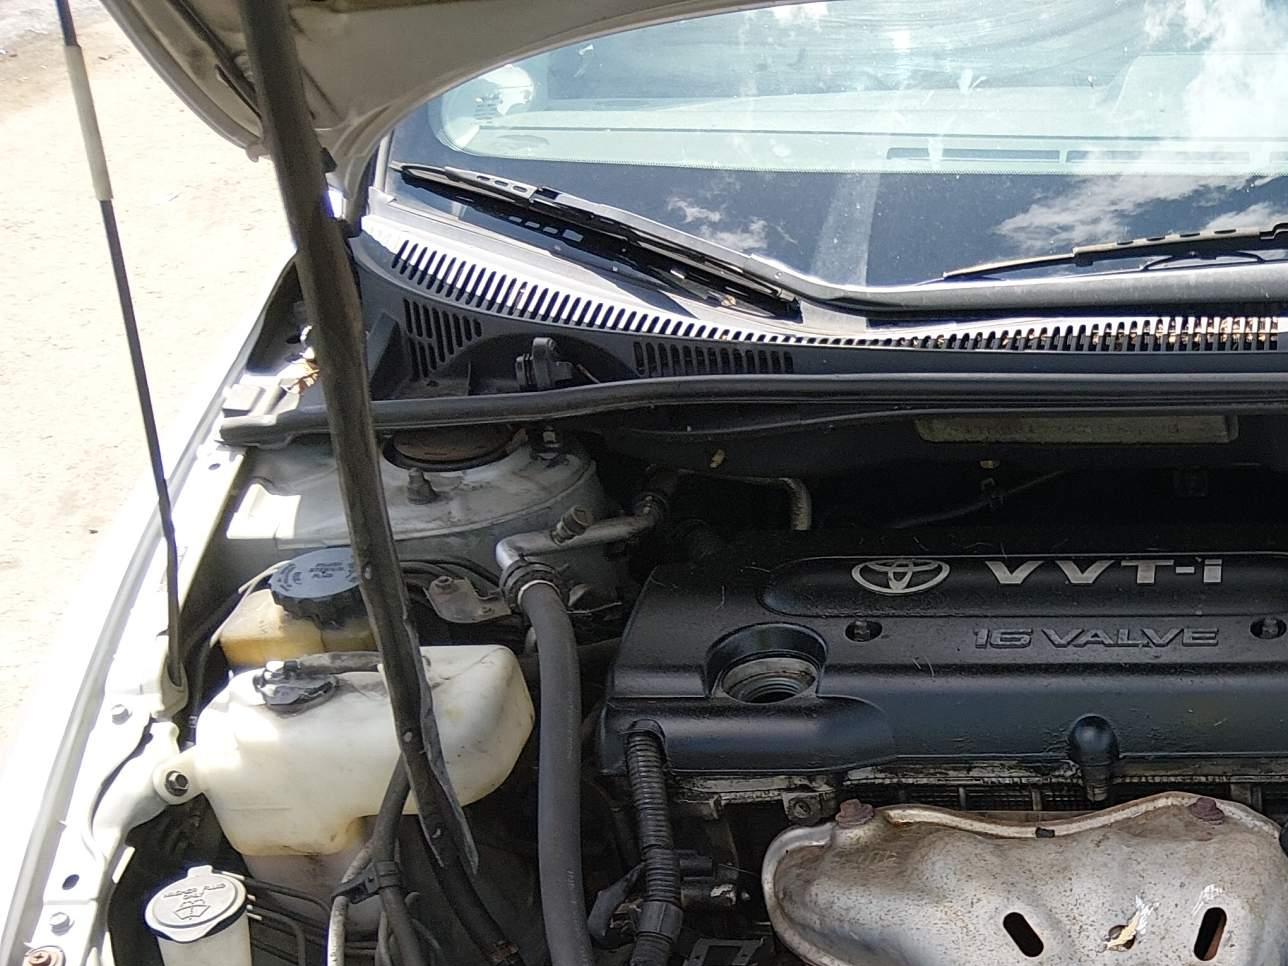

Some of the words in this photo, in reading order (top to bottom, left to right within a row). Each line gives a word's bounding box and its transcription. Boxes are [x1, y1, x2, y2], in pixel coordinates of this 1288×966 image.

[985, 559, 1223, 585] VVT-i
[973, 627, 1034, 649] 16
[1041, 627, 1220, 649] VALVE
